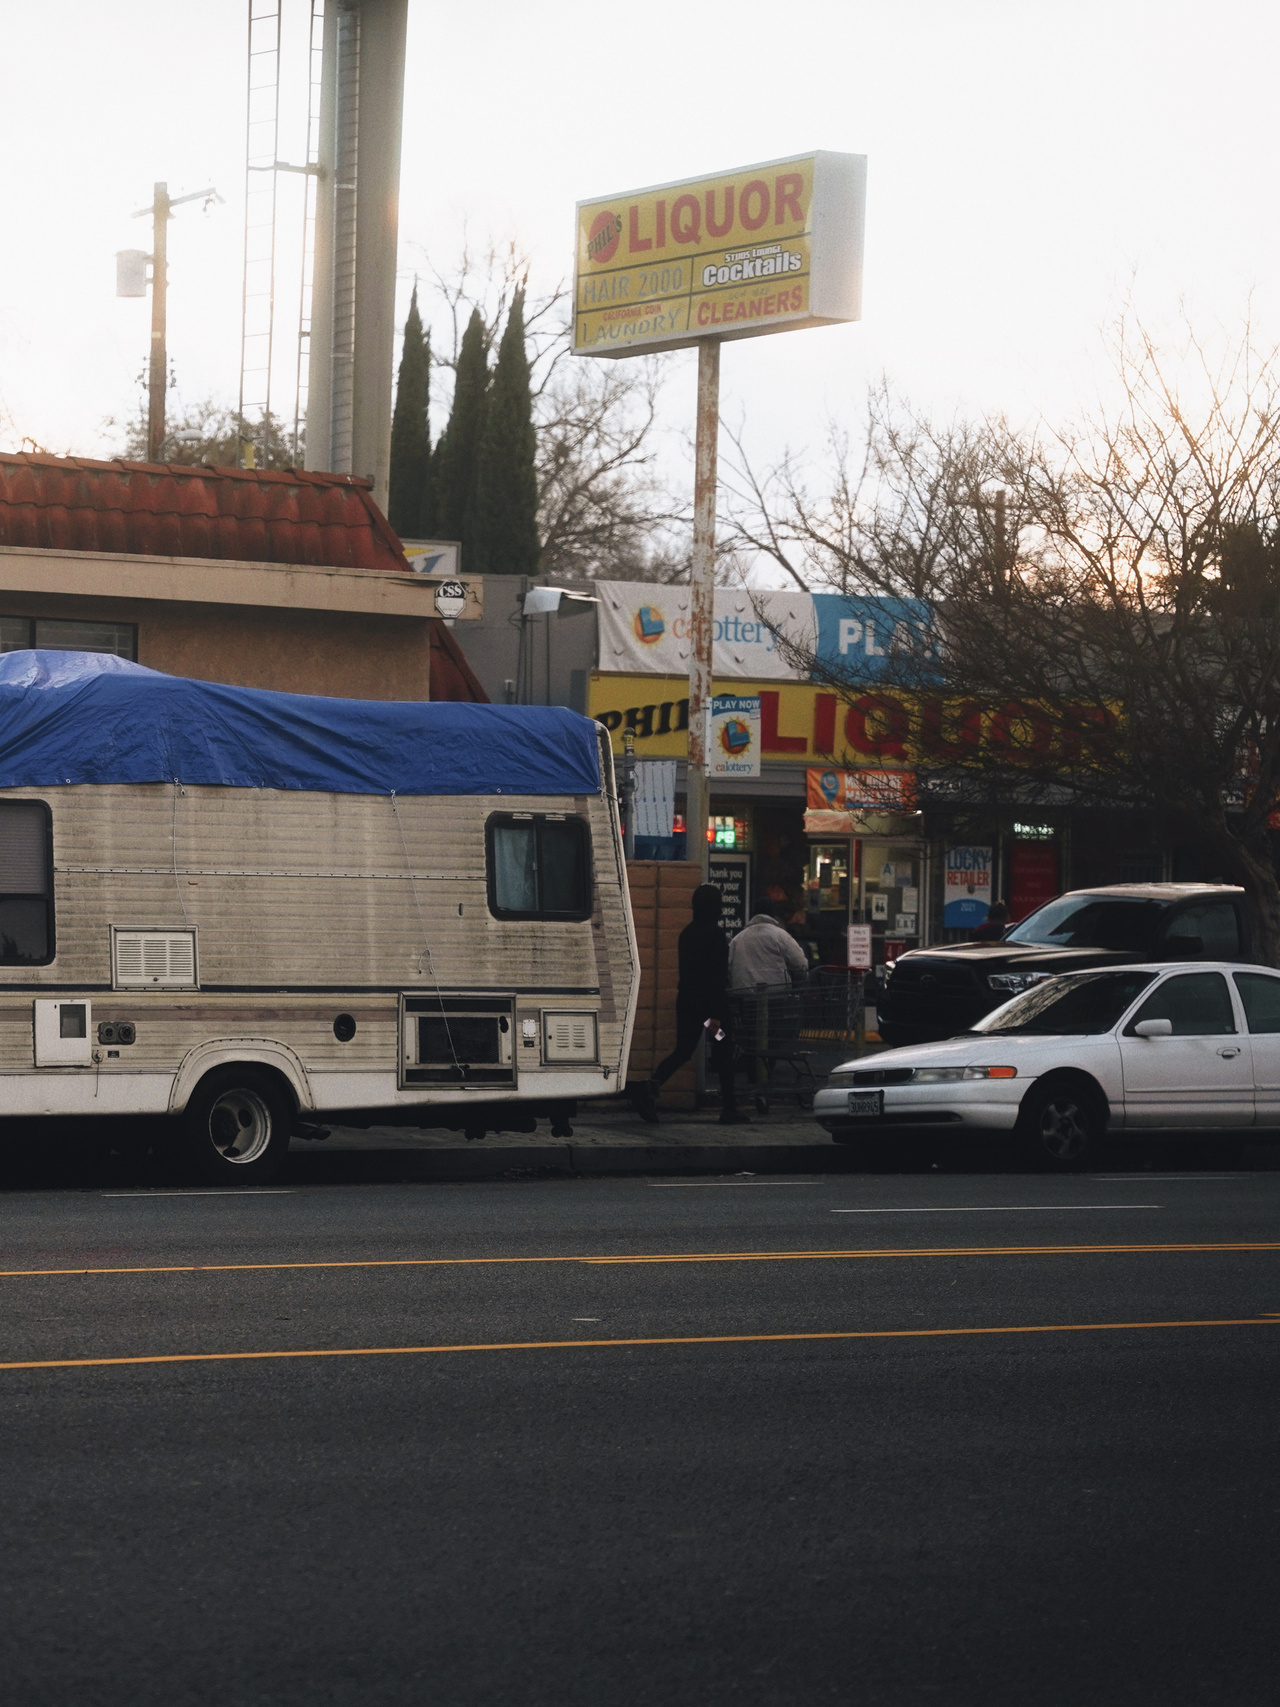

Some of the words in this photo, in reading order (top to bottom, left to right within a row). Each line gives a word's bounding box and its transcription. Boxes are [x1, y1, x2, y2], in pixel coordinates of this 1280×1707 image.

[629, 172, 805, 254] LIQUOR
[588, 214, 622, 260] PHIL'S
[751, 244, 782, 258] LOUNGE
[703, 251, 803, 288] Cocktails
[584, 276, 629, 304] HAIR
[637, 266, 683, 297] 2000
[603, 307, 641, 321] CALIFORNIA
[644, 304, 661, 316] COIN
[697, 285, 803, 326] CLEANERS
[583, 308, 680, 343] LAUNDRY
[439, 585, 462, 597] CSS
[713, 701, 737, 710] PLAY
[739, 699, 760, 709] NOW
[716, 761, 753, 774] calottery
[947, 871, 988, 885] RETAILER
